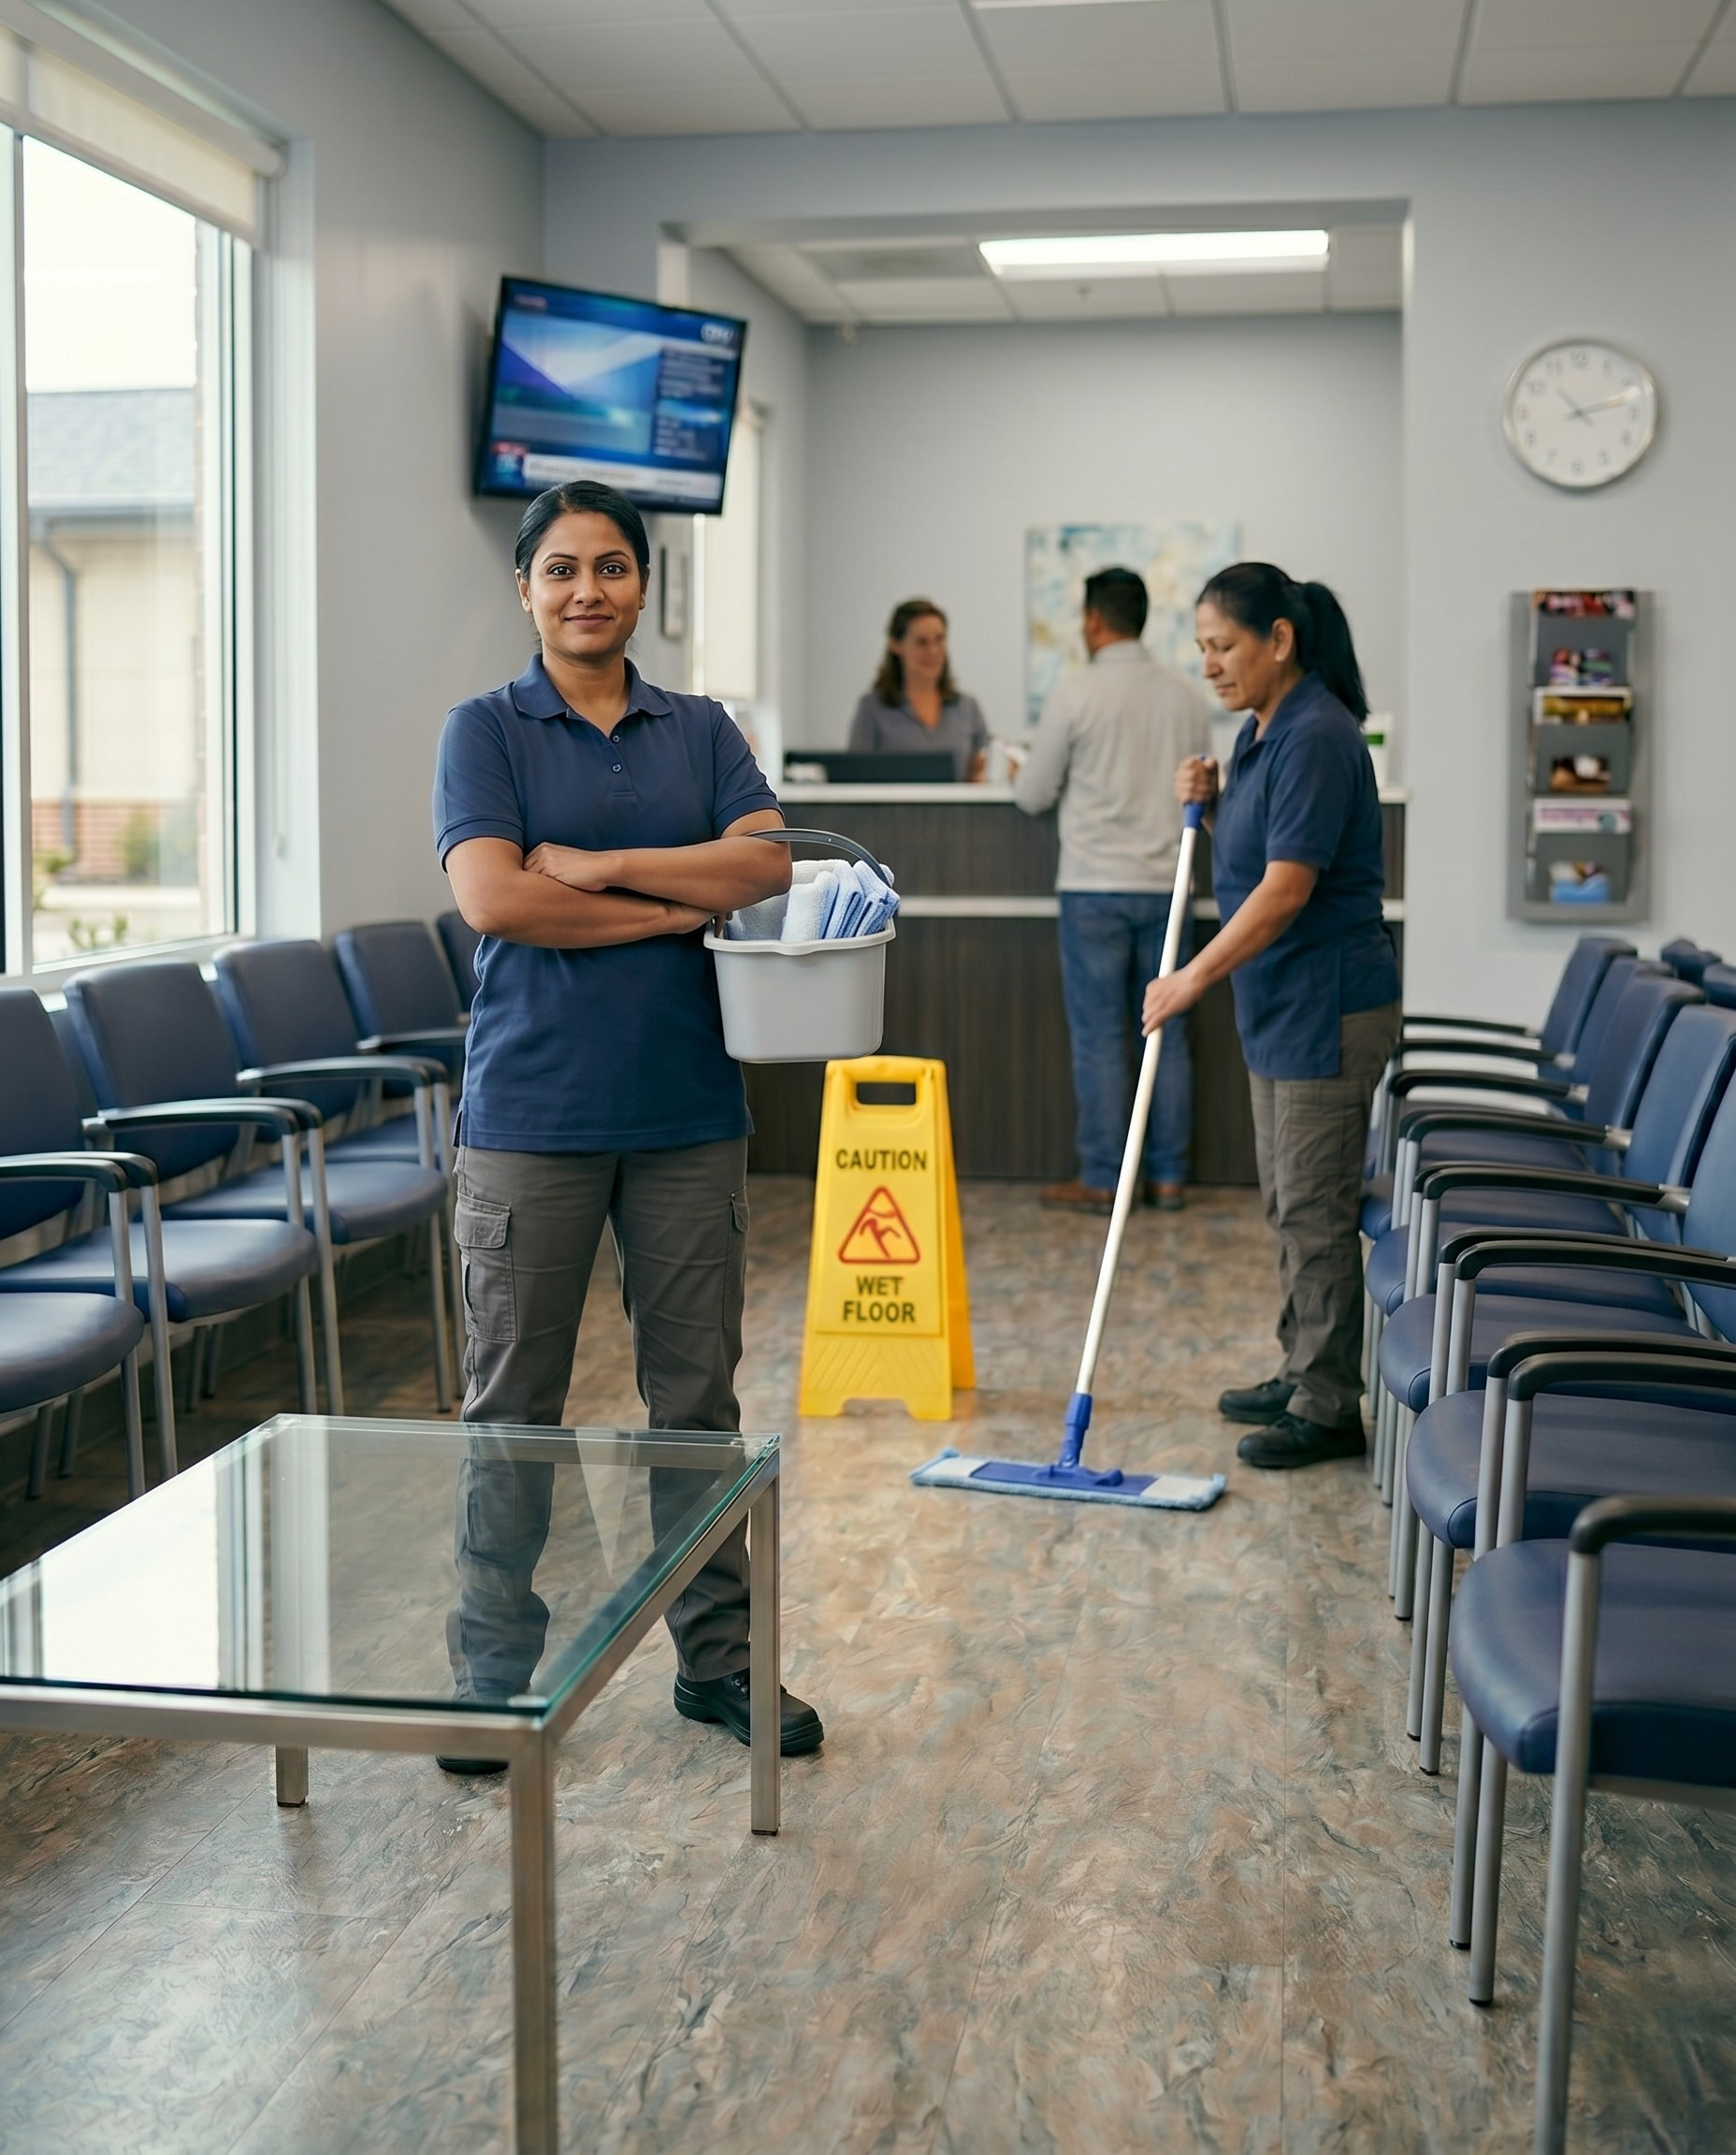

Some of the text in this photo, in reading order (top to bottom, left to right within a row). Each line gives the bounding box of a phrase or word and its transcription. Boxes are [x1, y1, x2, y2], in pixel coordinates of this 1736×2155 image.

[835, 1149, 927, 1170] CAUTION
[856, 1276, 904, 1295] WET
[843, 1300, 916, 1323] FLOOR
